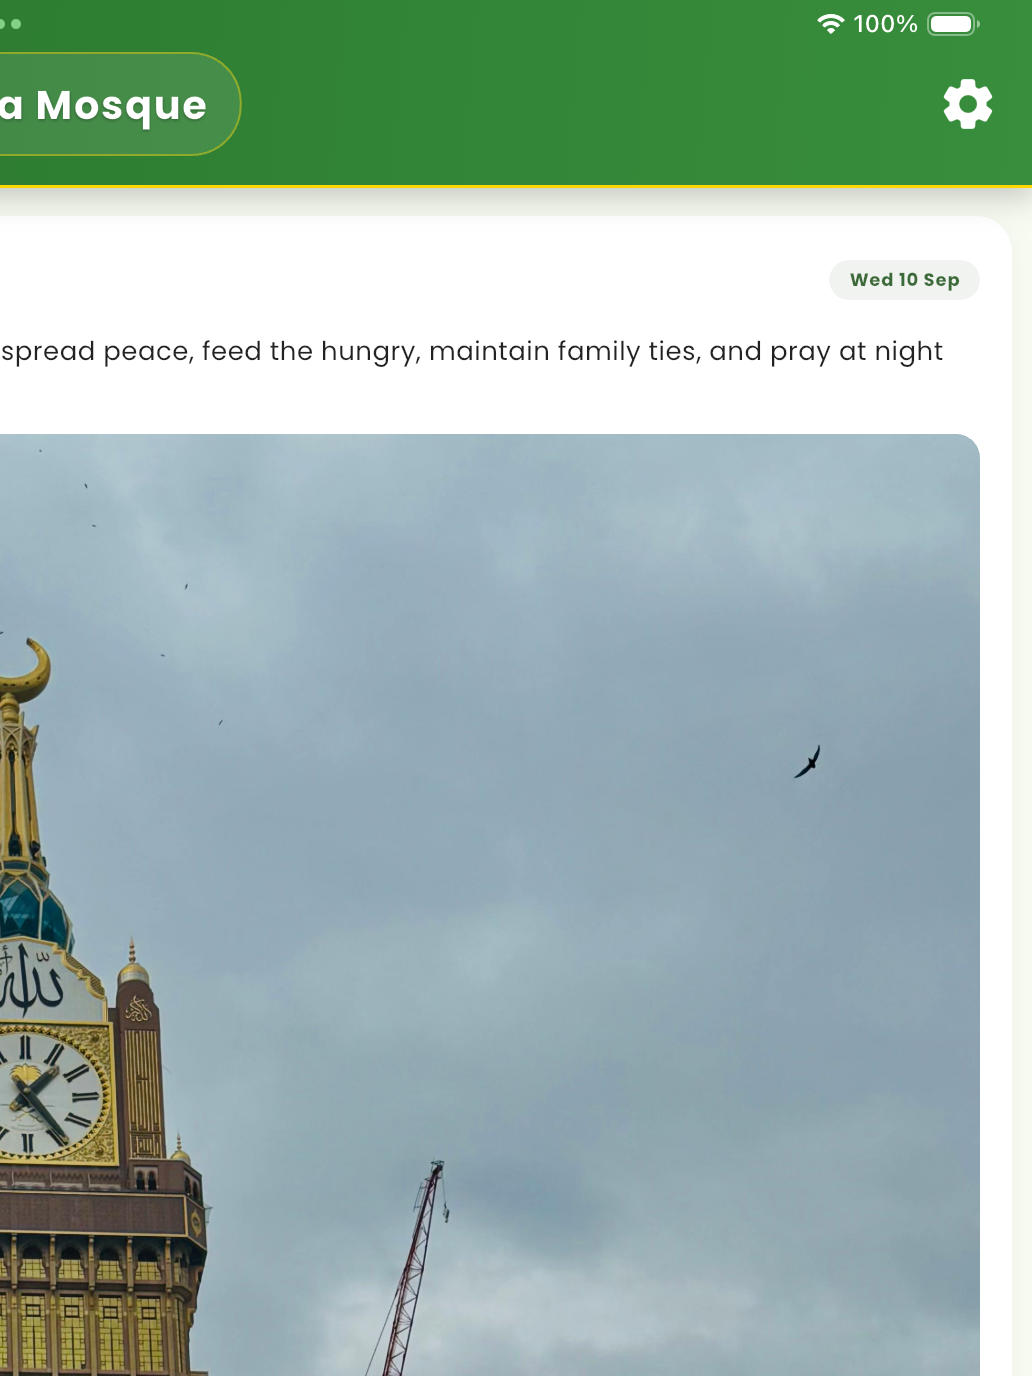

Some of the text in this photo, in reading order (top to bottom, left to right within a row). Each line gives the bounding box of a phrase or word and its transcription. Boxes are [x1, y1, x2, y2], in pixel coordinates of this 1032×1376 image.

[854, 14, 918, 33] 100%
[37, 90, 207, 130] Mosque
[849, 272, 960, 292] Wed 10 Sep
[1, 340, 94, 368] spread
[104, 340, 194, 368] peace,
[201, 339, 261, 361] feed
[269, 340, 313, 361] the
[322, 340, 421, 368] hungry,
[430, 339, 549, 361] maintain
[557, 339, 641, 368] family
[648, 339, 701, 365] ties,
[709, 340, 761, 361] and
[771, 344, 831, 368] pray
[839, 341, 867, 361] at
[875, 339, 943, 368] night
